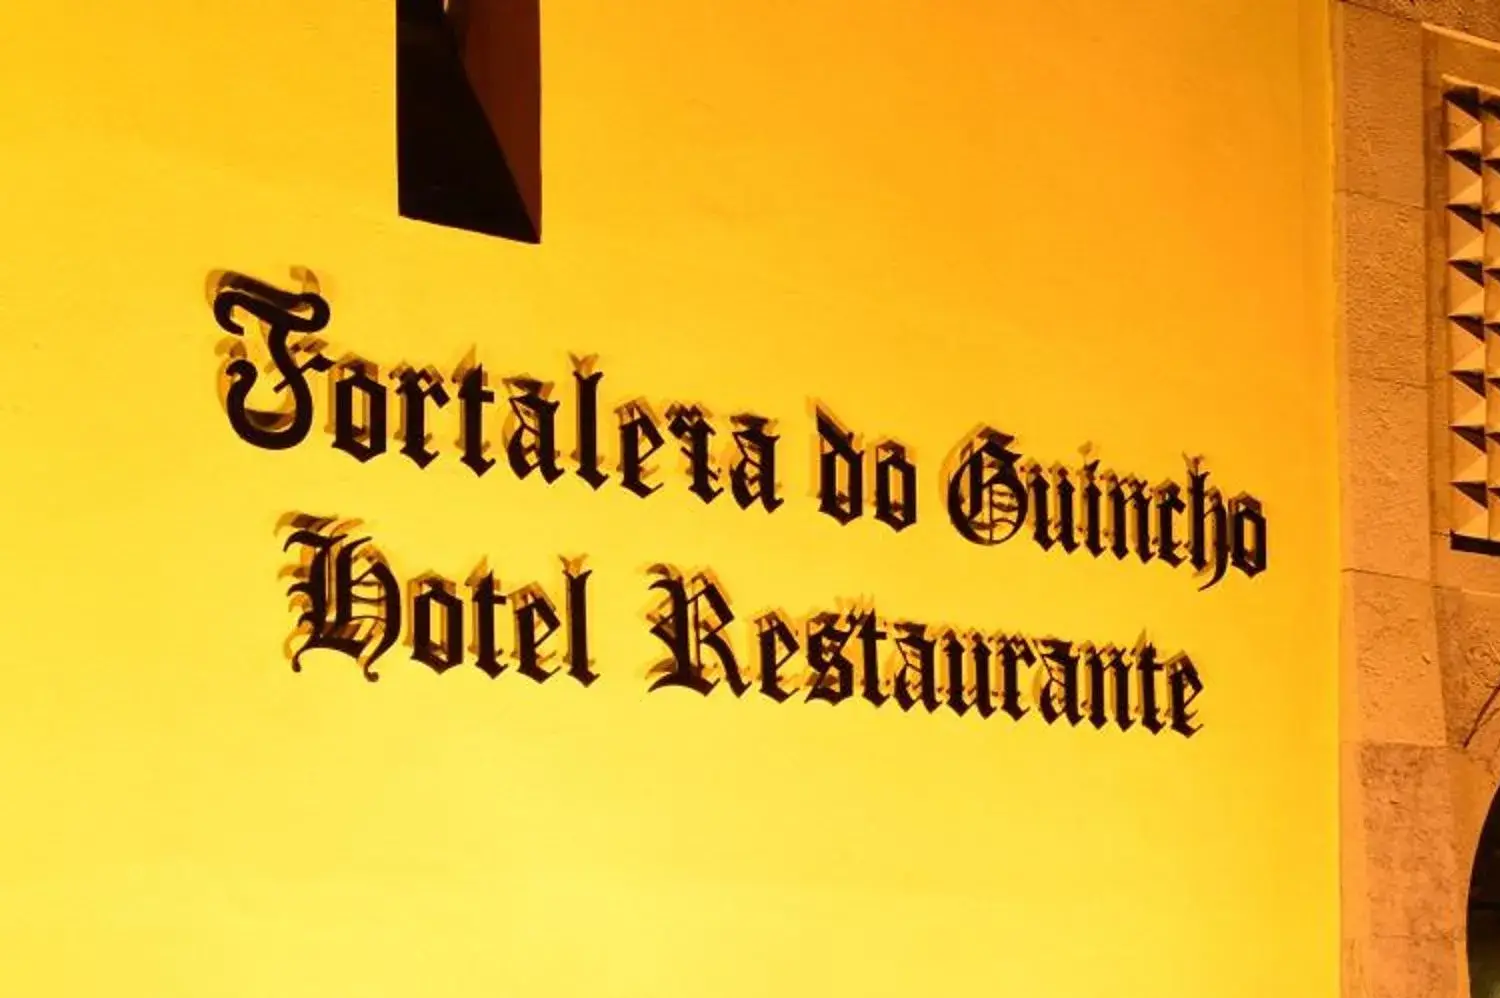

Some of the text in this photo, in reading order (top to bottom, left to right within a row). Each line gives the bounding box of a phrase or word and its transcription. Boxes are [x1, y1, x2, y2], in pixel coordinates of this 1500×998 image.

[814, 402, 917, 532] do
[944, 422, 1268, 591] Guincho
[284, 525, 1205, 738] Hotel Restaurante
